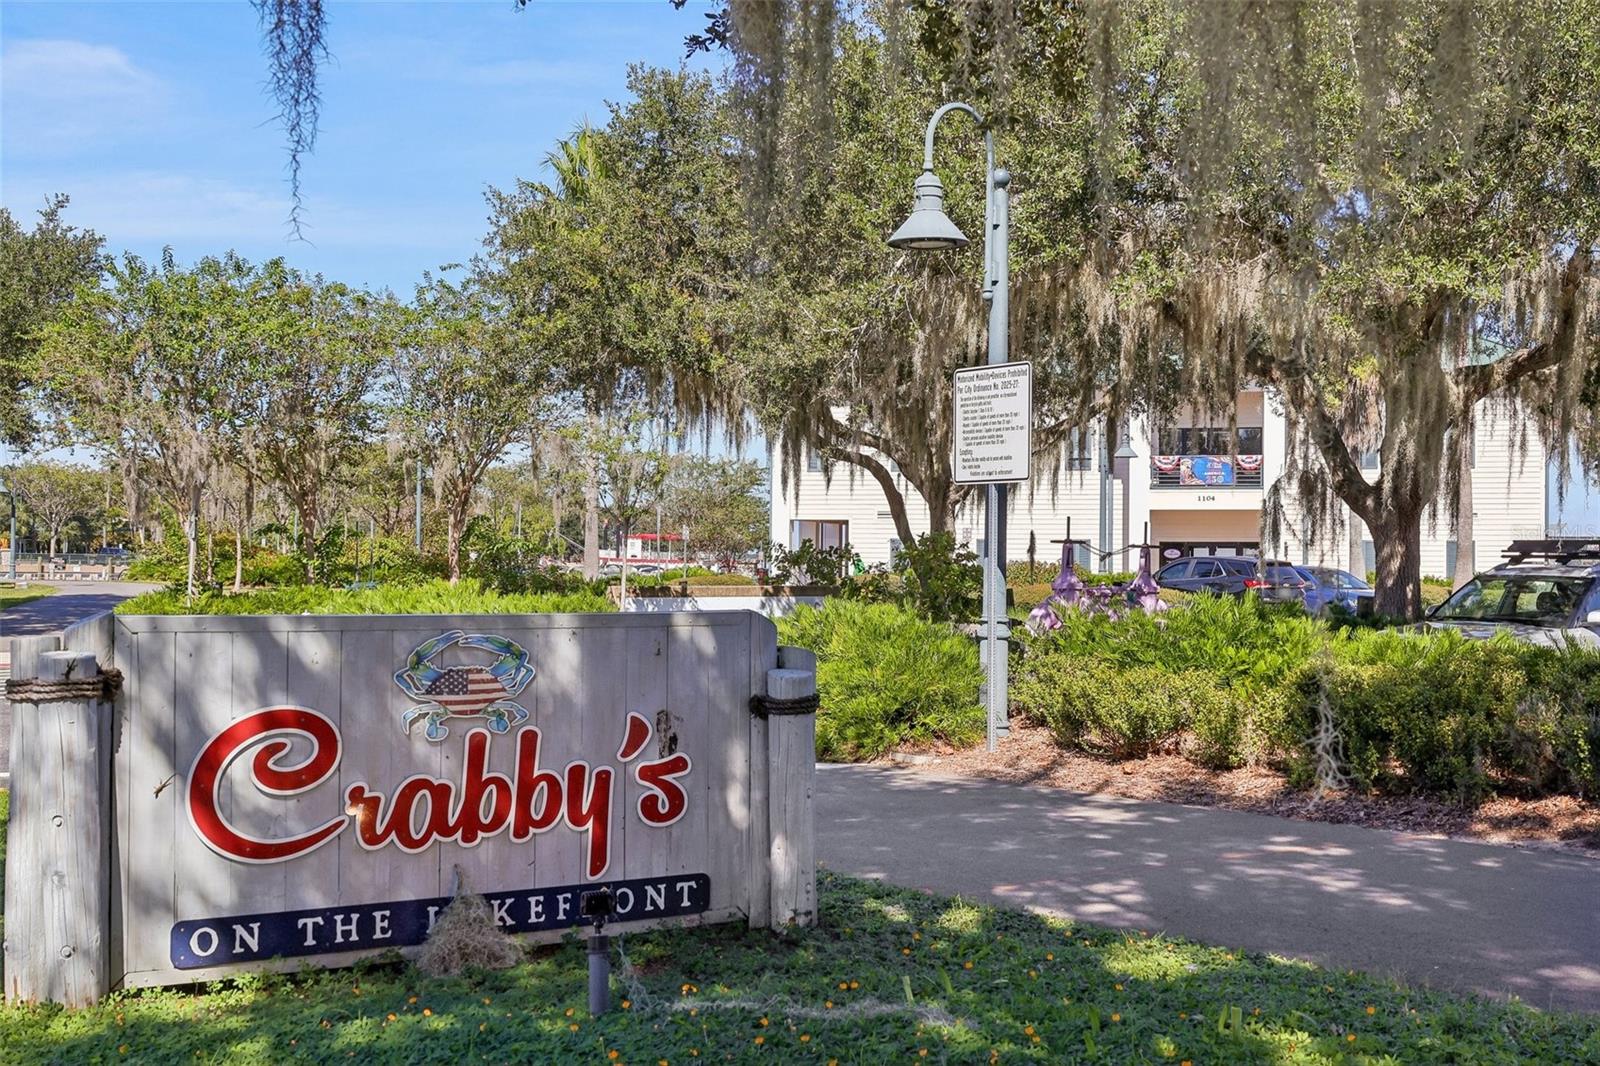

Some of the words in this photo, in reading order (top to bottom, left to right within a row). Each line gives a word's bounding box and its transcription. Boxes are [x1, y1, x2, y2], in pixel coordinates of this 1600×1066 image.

[964, 385, 972, 395] City
[185, 704, 692, 881] Crabby's
[189, 922, 261, 957] ON
[297, 909, 393, 947] THE
[426, 880, 698, 934] LKEFONT
